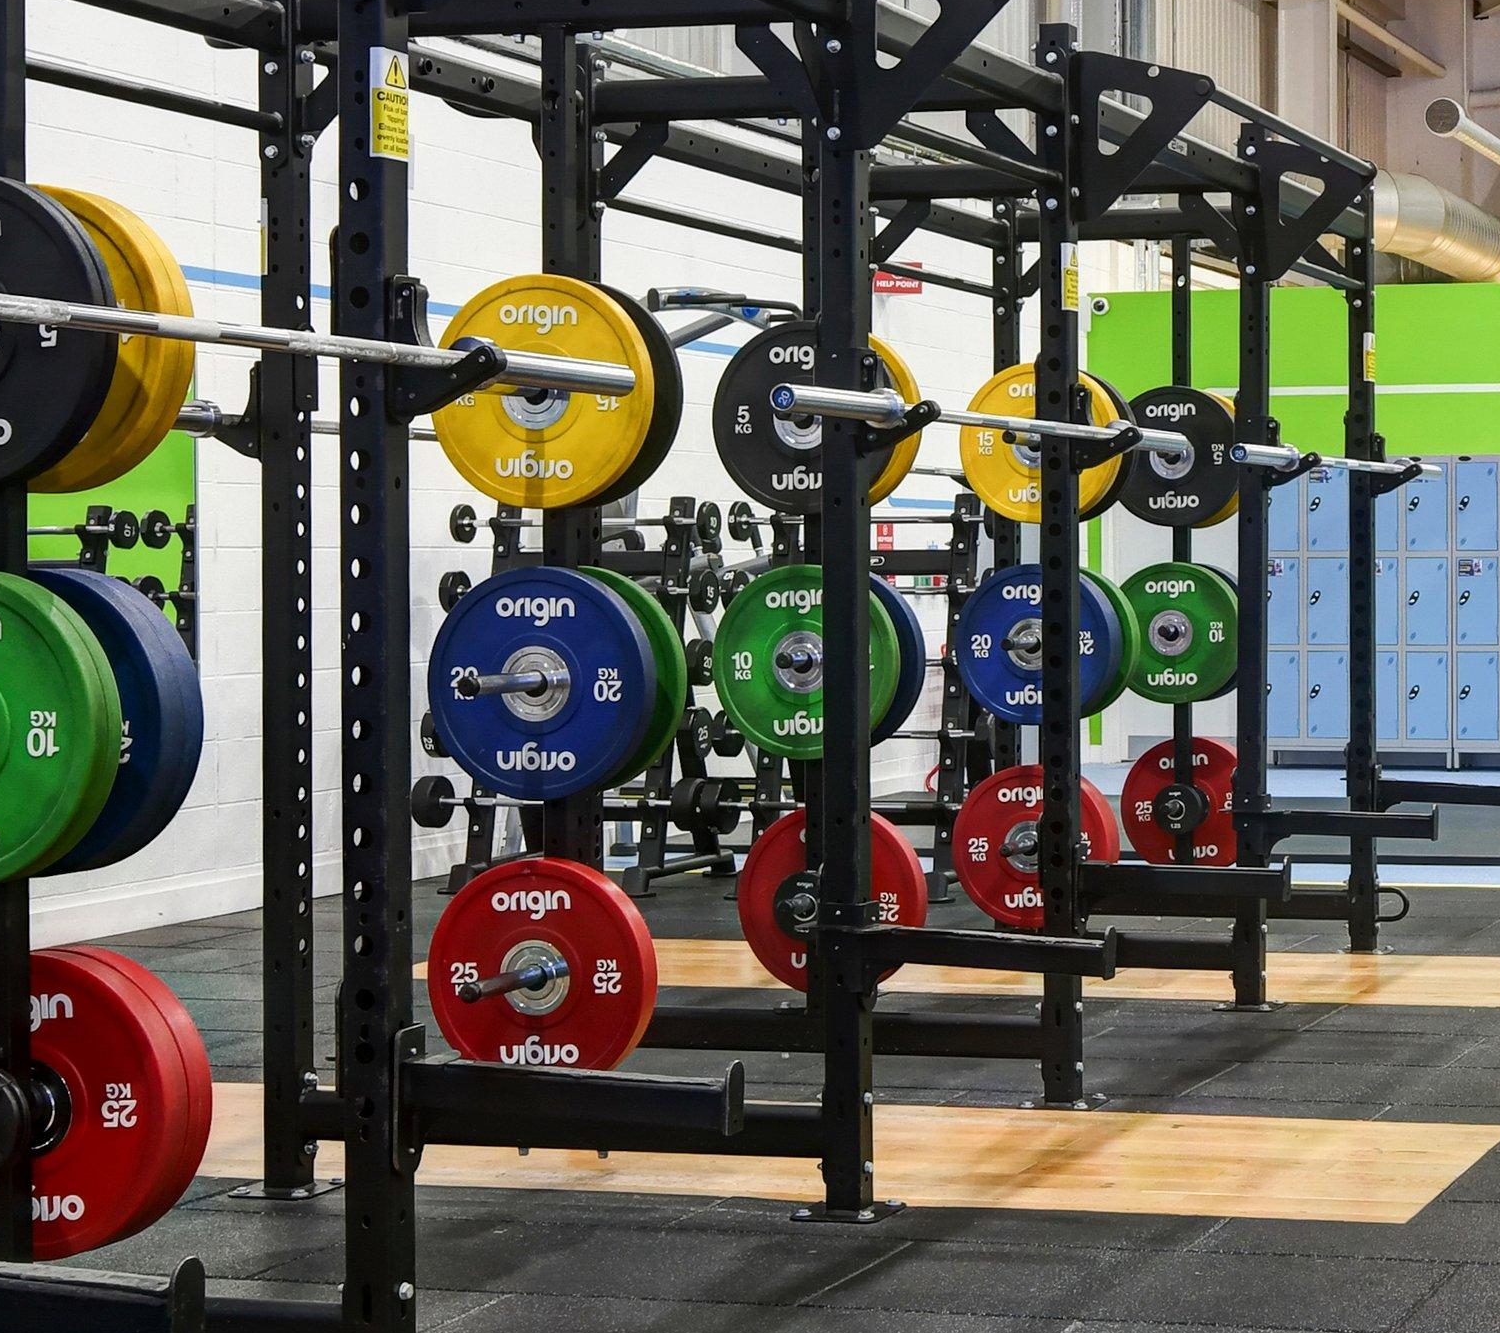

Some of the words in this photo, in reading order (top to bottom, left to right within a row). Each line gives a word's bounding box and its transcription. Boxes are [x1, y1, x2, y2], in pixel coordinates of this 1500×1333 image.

[377, 91, 408, 107] CAUTIO
[895, 280, 919, 288] POINT
[500, 304, 578, 334] origin
[769, 345, 815, 370] orig
[1007, 383, 1037, 399] ori
[737, 405, 750, 423] 5
[1145, 403, 1196, 423] origin
[734, 423, 752, 434] KG
[976, 432, 995, 447] 15
[1211, 443, 1224, 452] KG
[978, 447, 993, 455] KG
[1213, 451, 1223, 465] 5
[495, 450, 574, 480] origin
[771, 466, 823, 490] rigin
[1008, 483, 1041, 503] gin
[1148, 490, 1199, 509] origin
[1002, 585, 1042, 605] orig
[1144, 579, 1196, 598] origin
[496, 597, 576, 627] origin
[1210, 621, 1223, 629] KG
[971, 634, 991, 650] 20
[1209, 629, 1225, 643] 10
[731, 651, 753, 669] 10
[974, 650, 989, 659] KG
[597, 668, 618, 679] KG
[734, 670, 752, 680] KG
[1147, 668, 1198, 686] origin
[593, 680, 622, 702] 20
[1006, 685, 1043, 705] igin
[30, 710, 57, 726] KG
[773, 710, 824, 736] rigin
[26, 727, 59, 757] 10
[497, 741, 576, 772] origin
[997, 786, 1043, 807] origi
[1135, 801, 1153, 814] 25
[967, 838, 989, 853] 25
[971, 853, 987, 862] KG
[491, 890, 571, 920] origin
[880, 892, 897, 903] KG
[1004, 886, 1044, 909] igin
[450, 962, 479, 984] 25
[596, 959, 617, 971] KG
[593, 971, 622, 994] 25
[499, 1035, 579, 1065] origin
[105, 1083, 132, 1099] KG
[102, 1099, 138, 1128] 25
